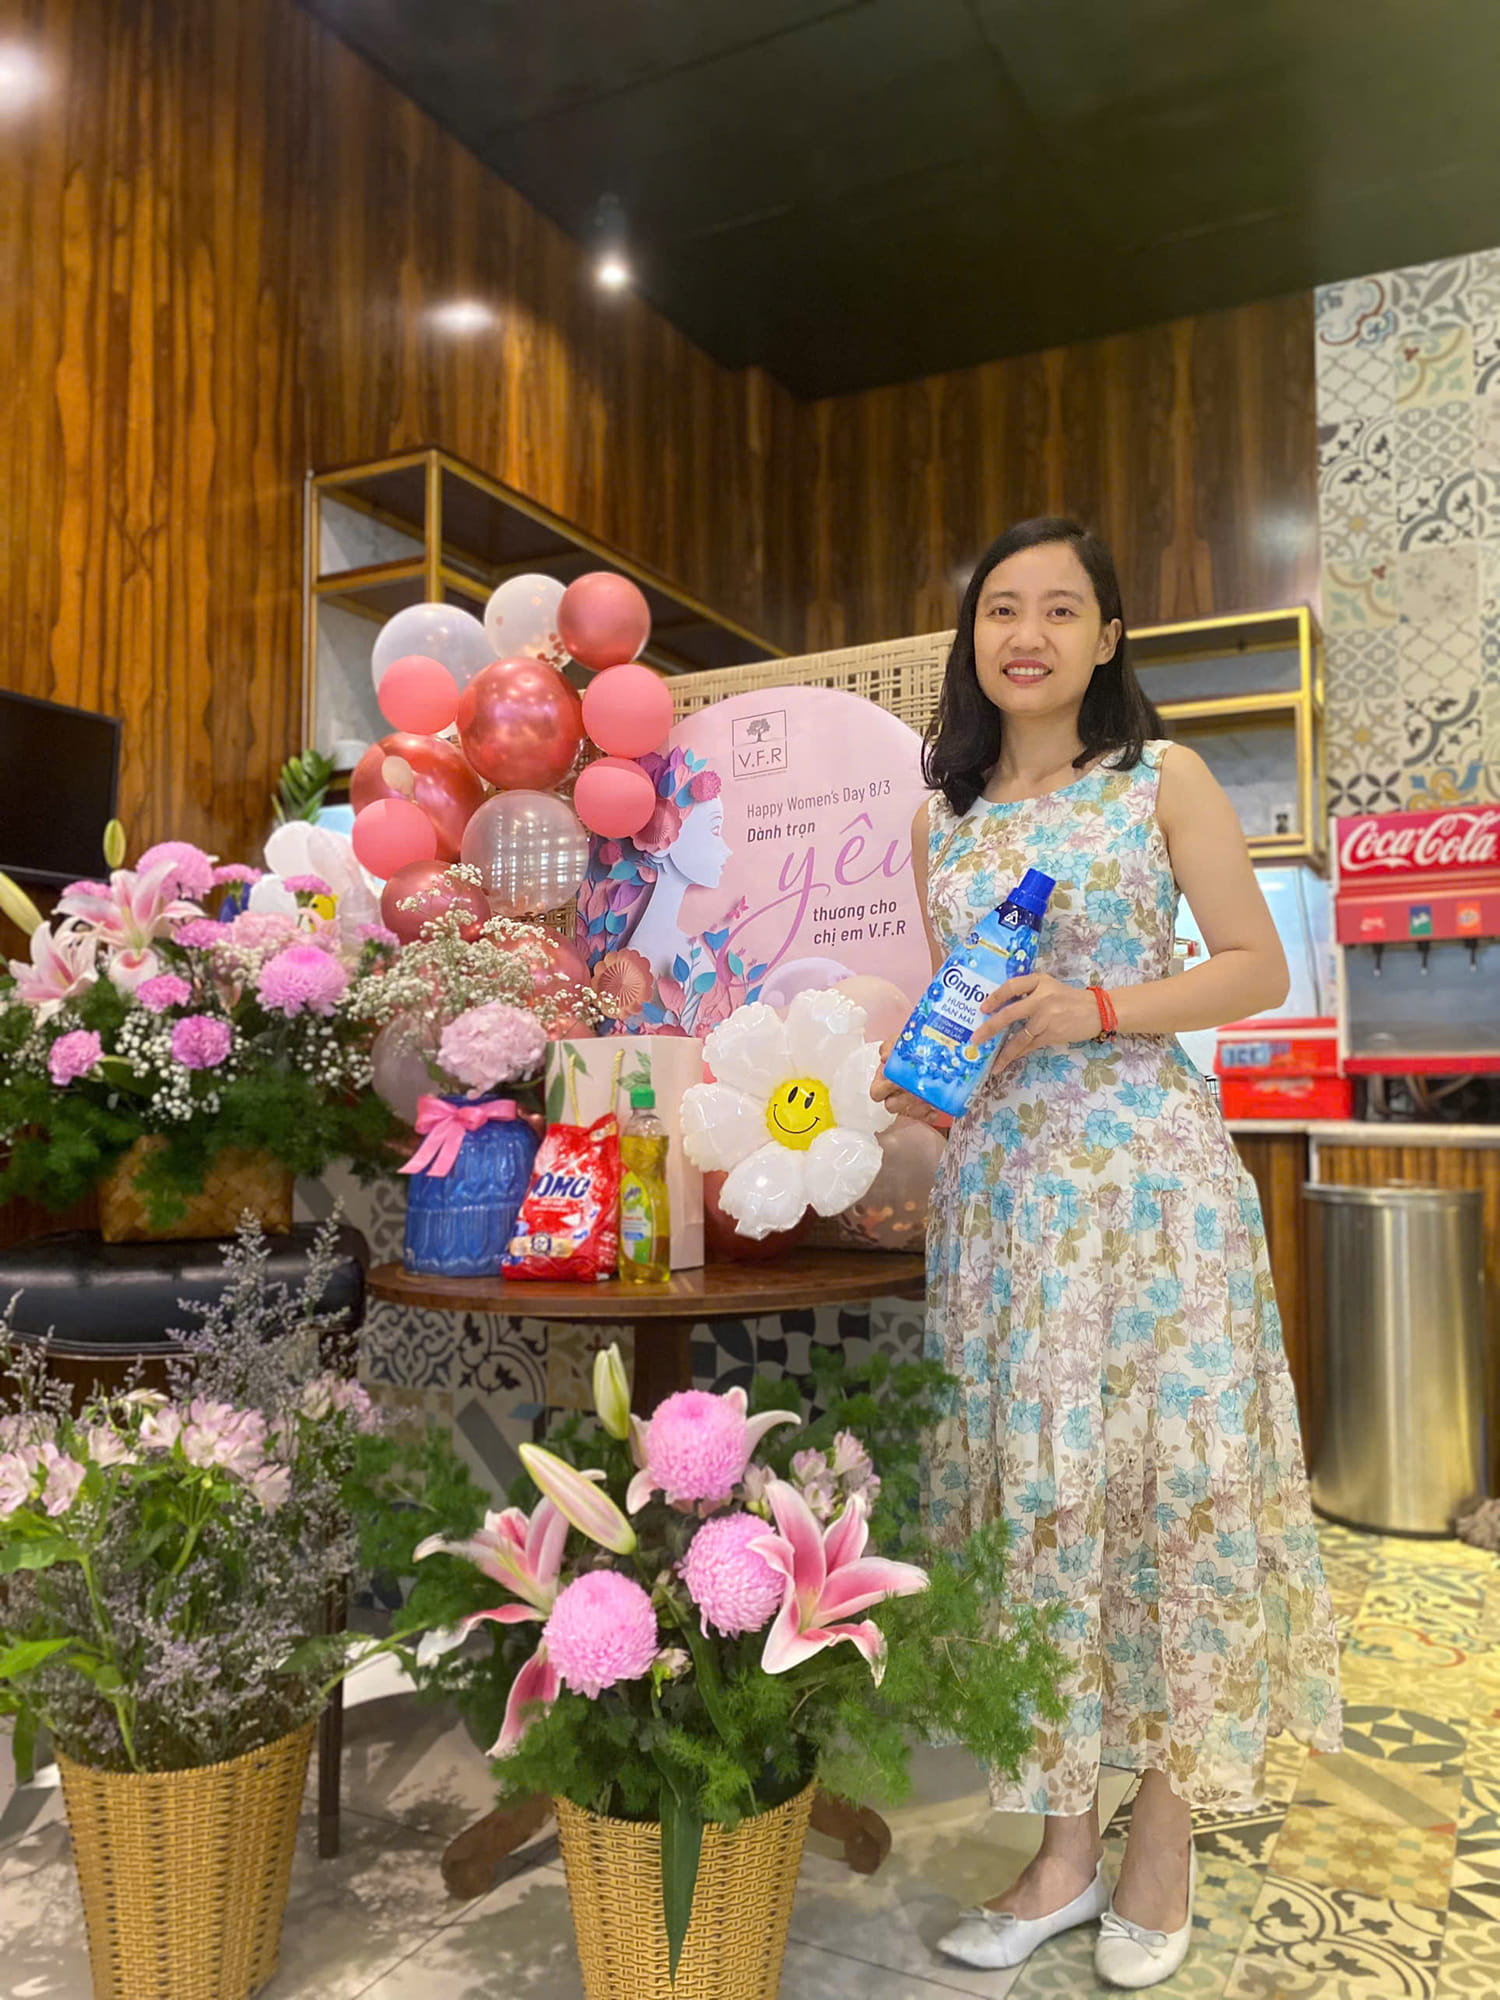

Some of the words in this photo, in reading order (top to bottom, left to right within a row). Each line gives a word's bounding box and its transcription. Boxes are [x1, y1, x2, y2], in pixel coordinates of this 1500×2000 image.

[738, 747, 782, 768] V.F.R
[747, 802, 783, 819] Happy
[787, 791, 840, 811] Women's
[843, 786, 865, 803] Day
[869, 780, 891, 797] 8/3
[747, 824, 781, 843] Dành
[786, 821, 816, 839] trọn
[813, 905, 865, 921] thương
[870, 898, 897, 915] cho
[814, 927, 836, 947] chị
[841, 928, 863, 941] em
[868, 919, 906, 938] V.F.R
[943, 968, 989, 1003] Comfo
[533, 1172, 591, 1198] OMO
